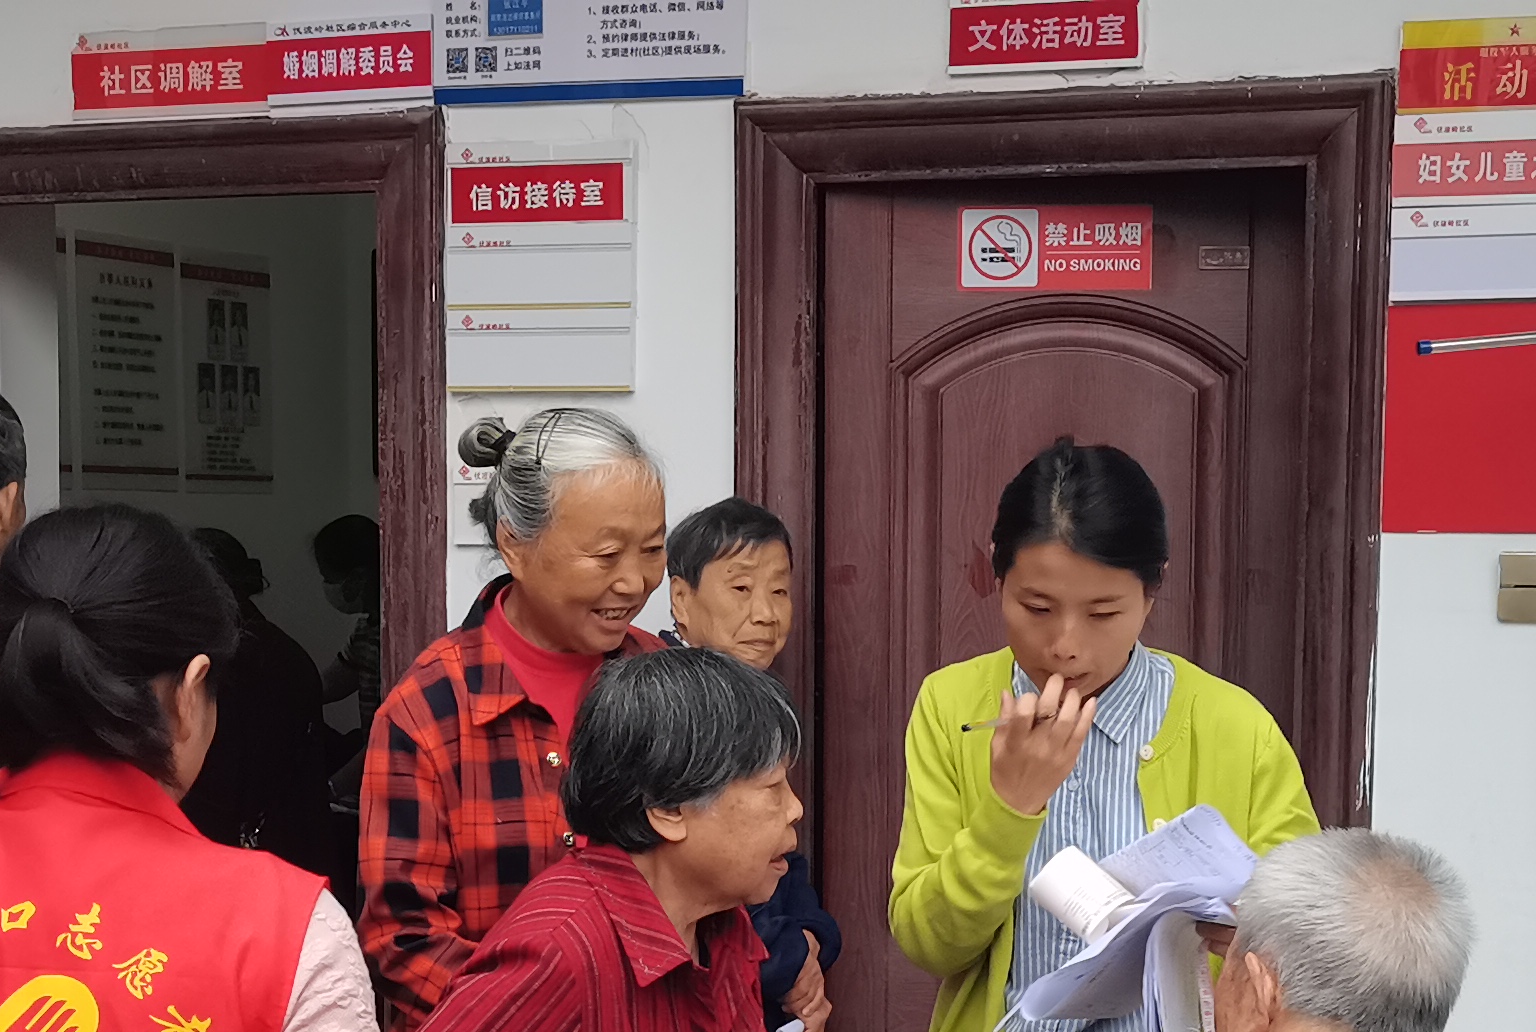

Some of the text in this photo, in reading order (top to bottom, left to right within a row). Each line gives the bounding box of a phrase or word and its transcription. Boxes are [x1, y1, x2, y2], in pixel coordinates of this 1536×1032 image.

[967, 14, 1126, 52] 文体活动室
[99, 58, 244, 96] 社区调解室
[283, 44, 414, 79] 婚姻调解委员会
[469, 179, 605, 212] 信访接待室
[1044, 222, 1142, 247] 禁止吸烟
[1044, 258, 1141, 272] NO SMOKING
